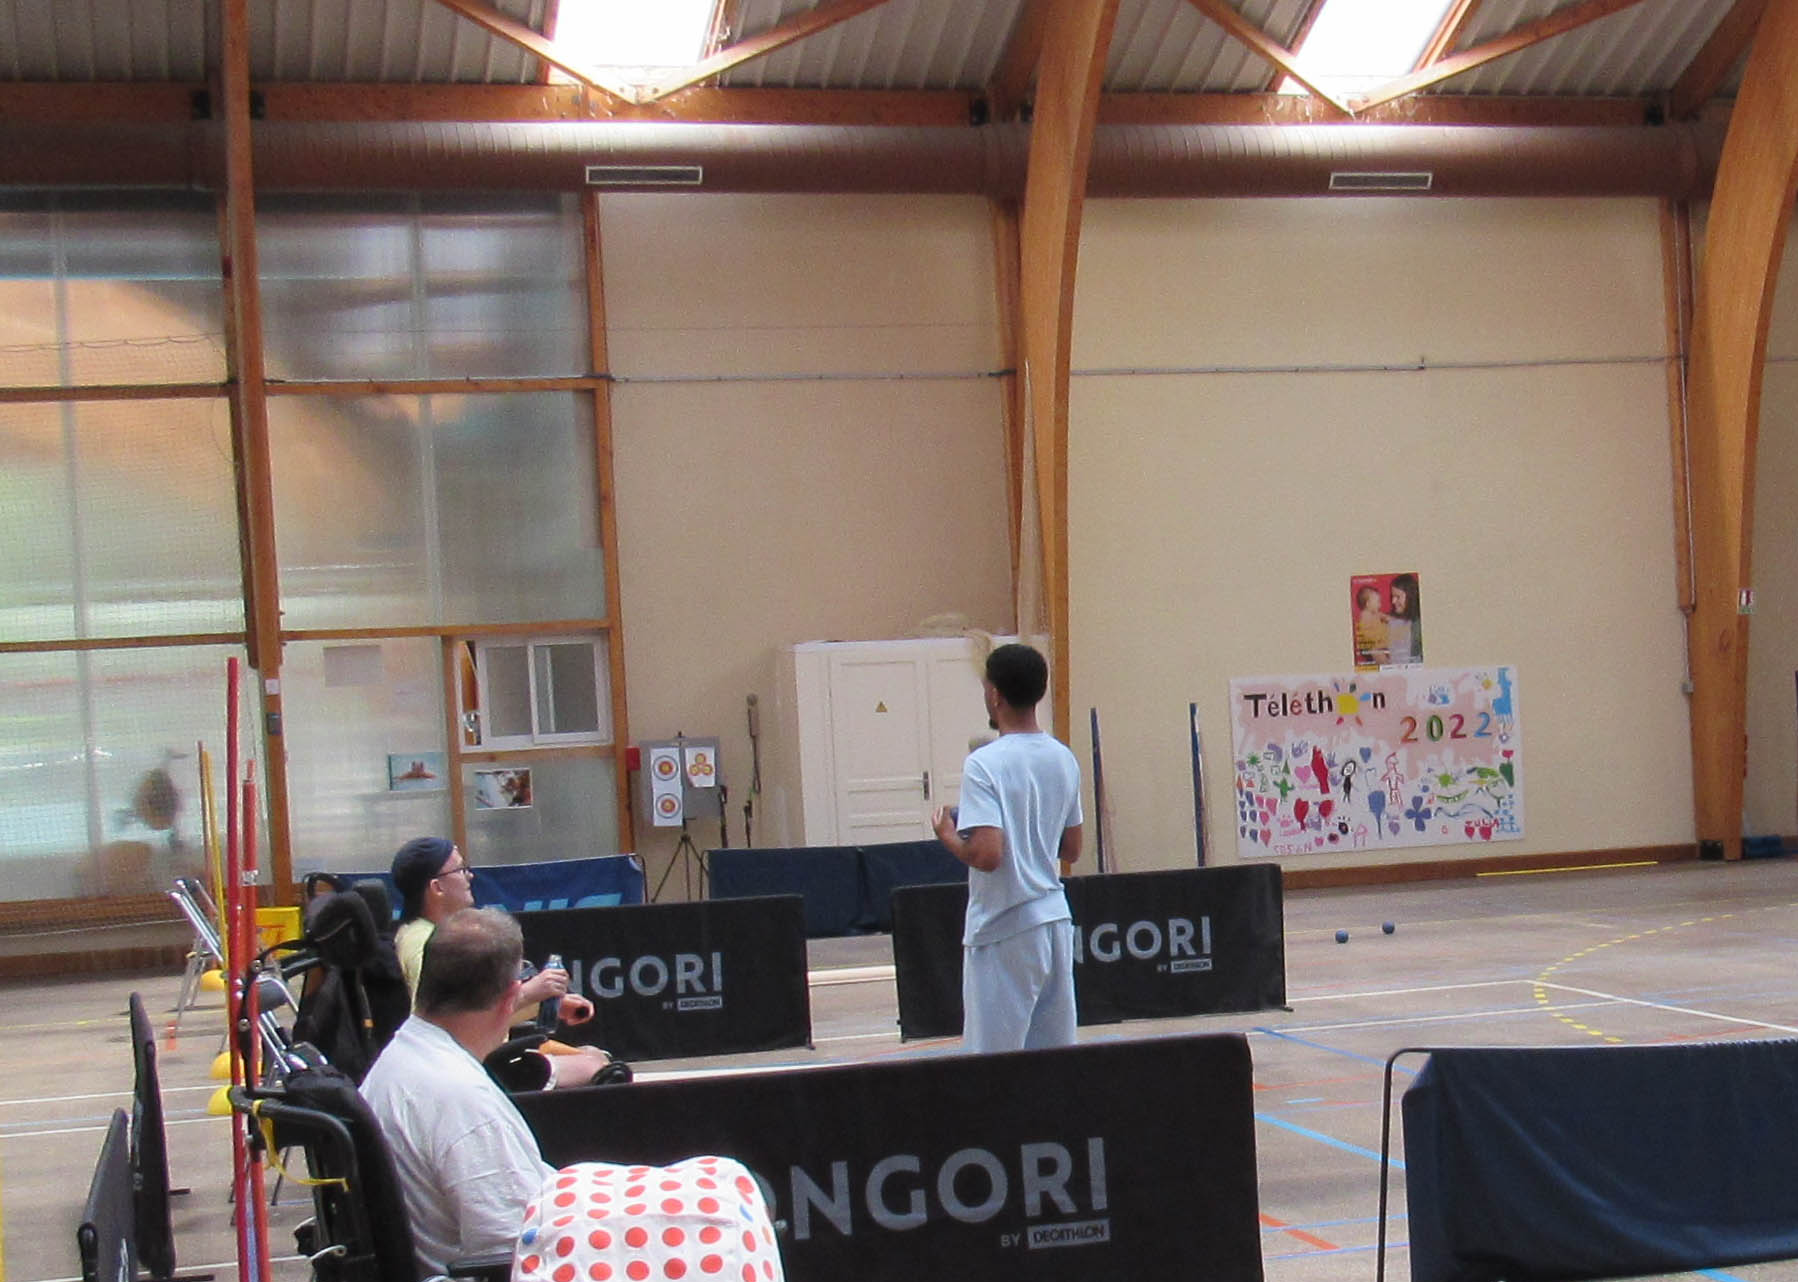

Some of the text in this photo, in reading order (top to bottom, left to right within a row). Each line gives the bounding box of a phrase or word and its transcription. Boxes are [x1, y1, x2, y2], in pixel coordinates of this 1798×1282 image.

[1400, 711, 1492, 744] 2022
[752, 1136, 1108, 1241] NGORI
[1000, 1232, 1020, 1248] BY
